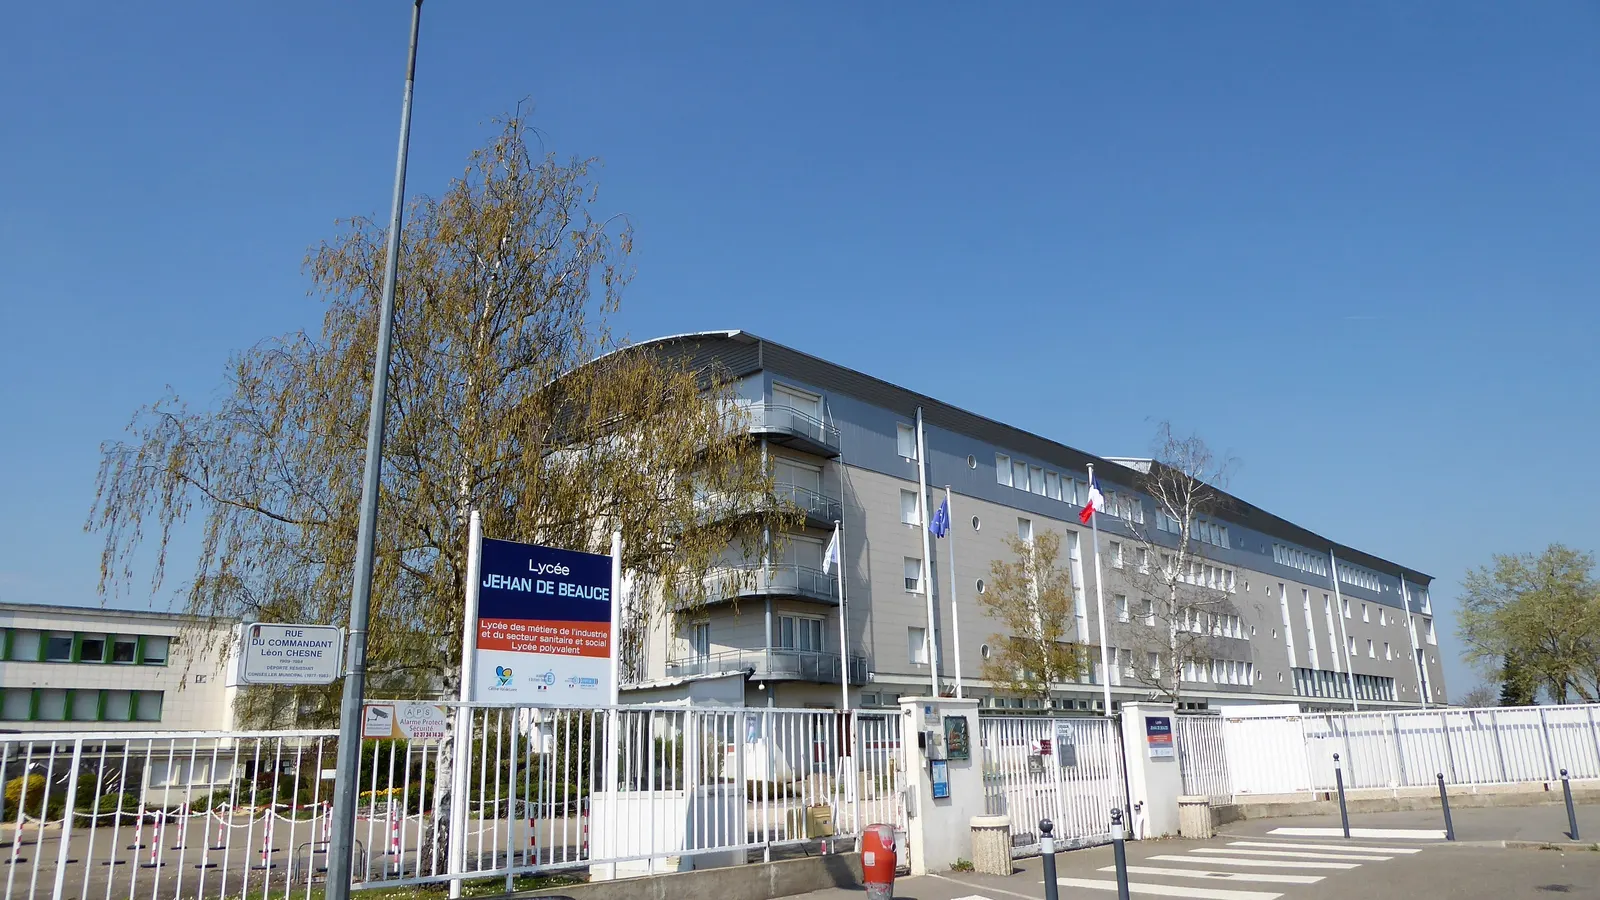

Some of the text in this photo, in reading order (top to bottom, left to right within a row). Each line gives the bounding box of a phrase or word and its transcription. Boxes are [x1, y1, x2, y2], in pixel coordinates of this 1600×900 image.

[528, 558, 570, 576] Lycée
[482, 573, 610, 601] JEHAN DE BEAUCE
[285, 629, 303, 638] RUE
[481, 620, 608, 639] Lycée des métiers de l'industrie
[252, 638, 333, 648] DU COMMANDANT
[481, 630, 607, 647] et du secteur sanitaire et social
[261, 648, 323, 658] Léon CHESNE
[511, 641, 580, 654] Lycée polyvalent
[400, 718, 421, 726] Alarme
